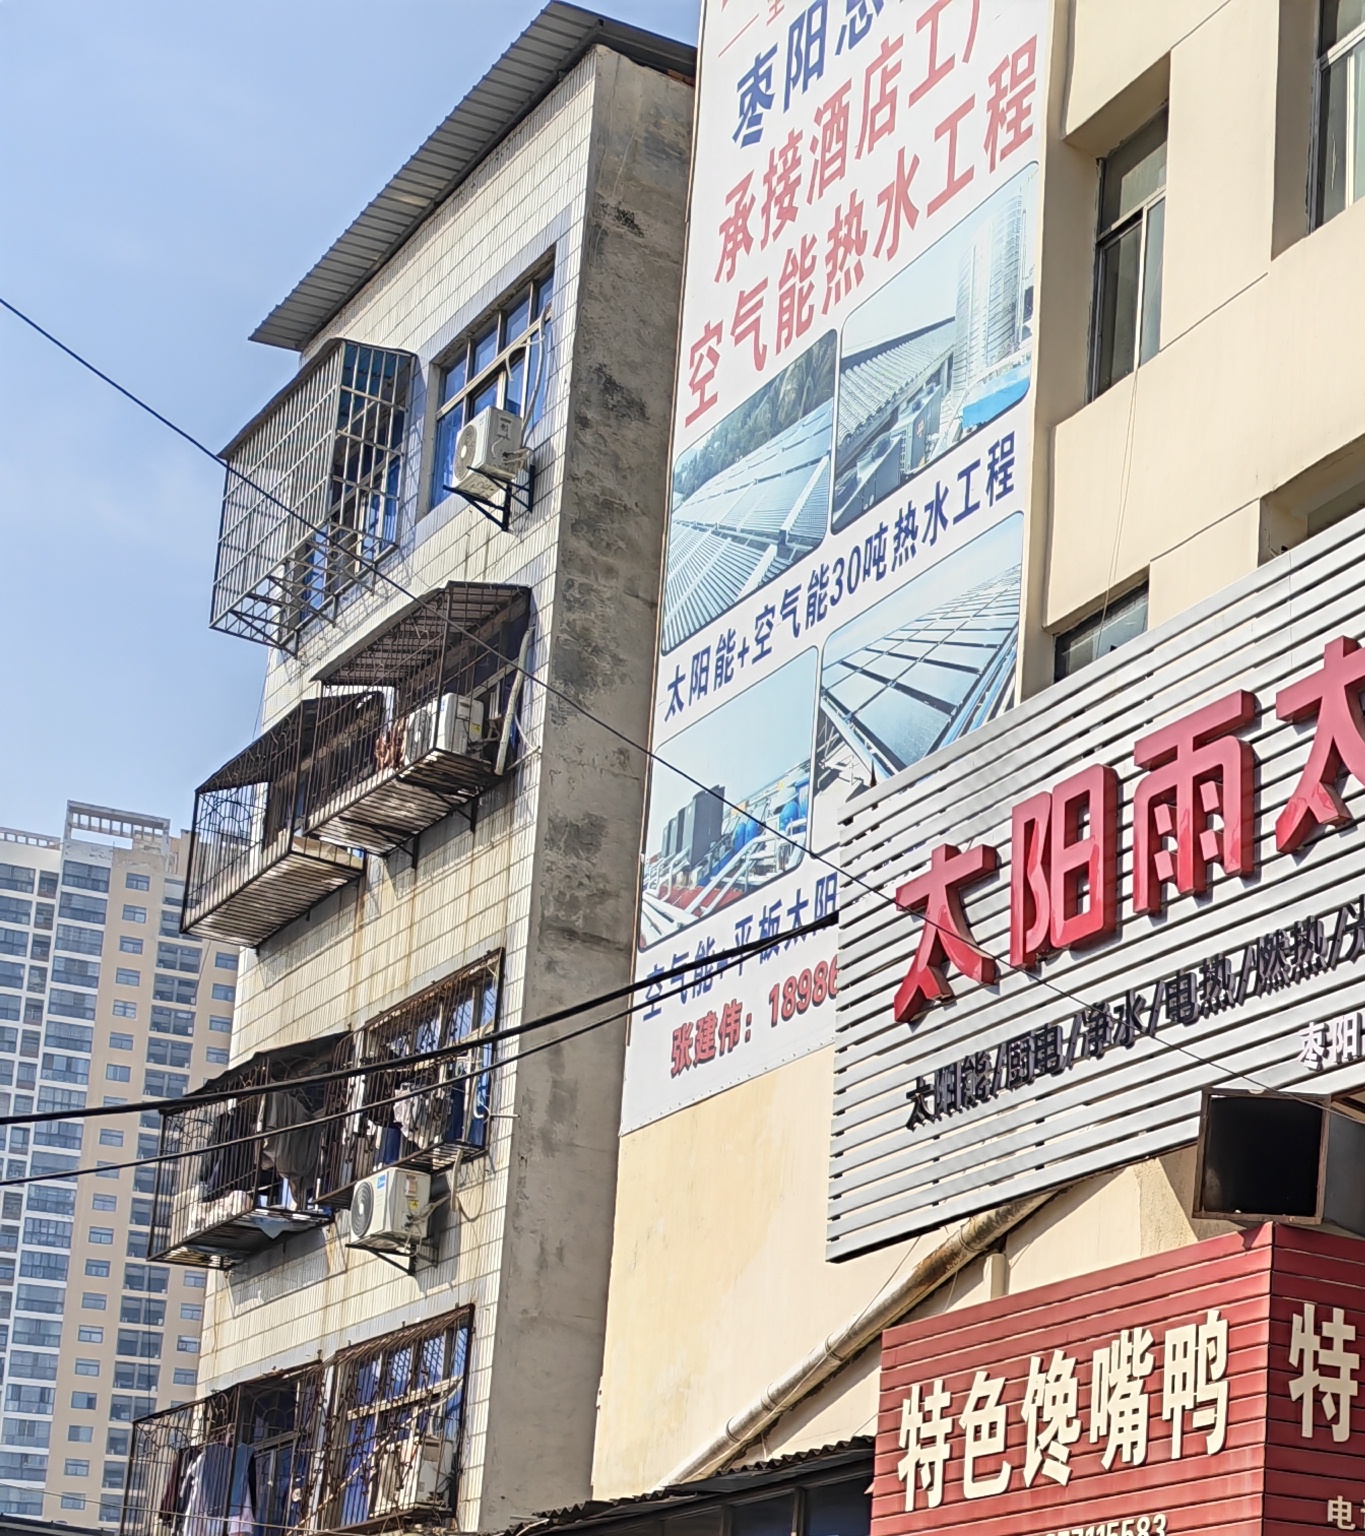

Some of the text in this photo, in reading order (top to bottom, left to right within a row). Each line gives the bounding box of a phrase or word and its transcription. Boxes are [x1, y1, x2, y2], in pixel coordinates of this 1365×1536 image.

[684, 34, 1038, 428] 空气能热水工程
[897, 1309, 1229, 1512] 特色馋嘴鸭
